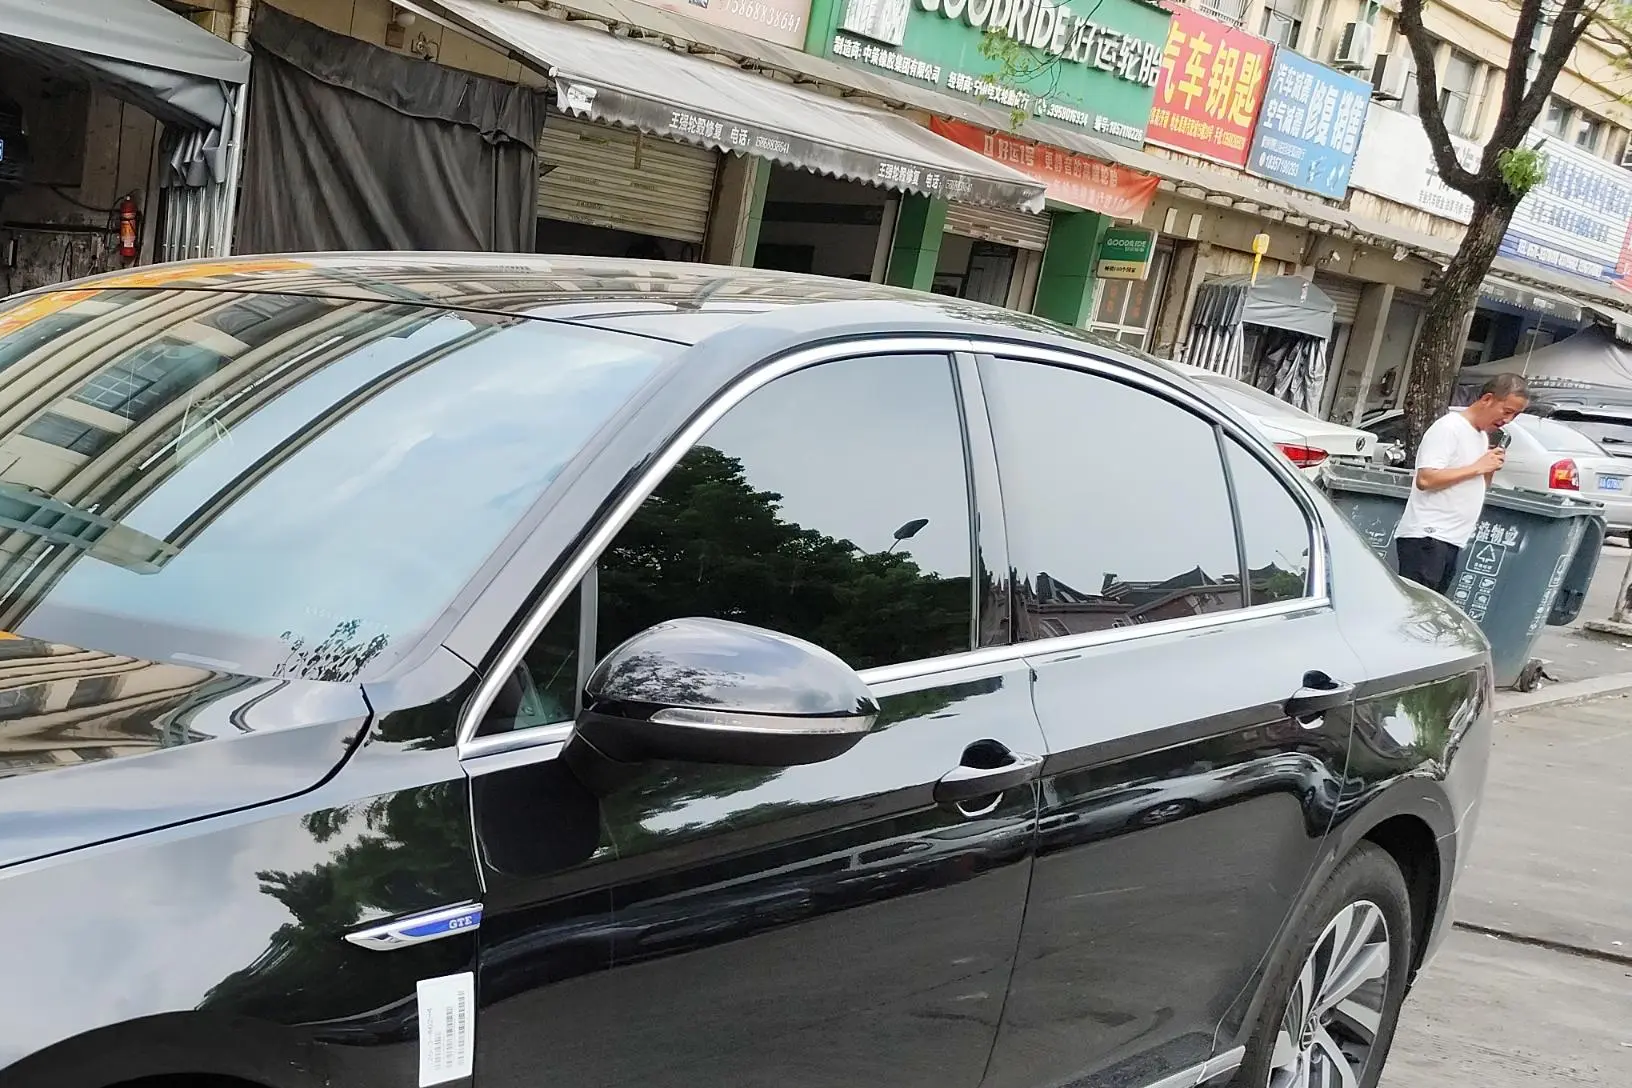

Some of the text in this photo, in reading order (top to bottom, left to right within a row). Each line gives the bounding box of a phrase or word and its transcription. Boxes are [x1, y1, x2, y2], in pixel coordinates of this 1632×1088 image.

[1071, 16, 1163, 87] 好运轮胎
[449, 915, 473, 930] GTE
